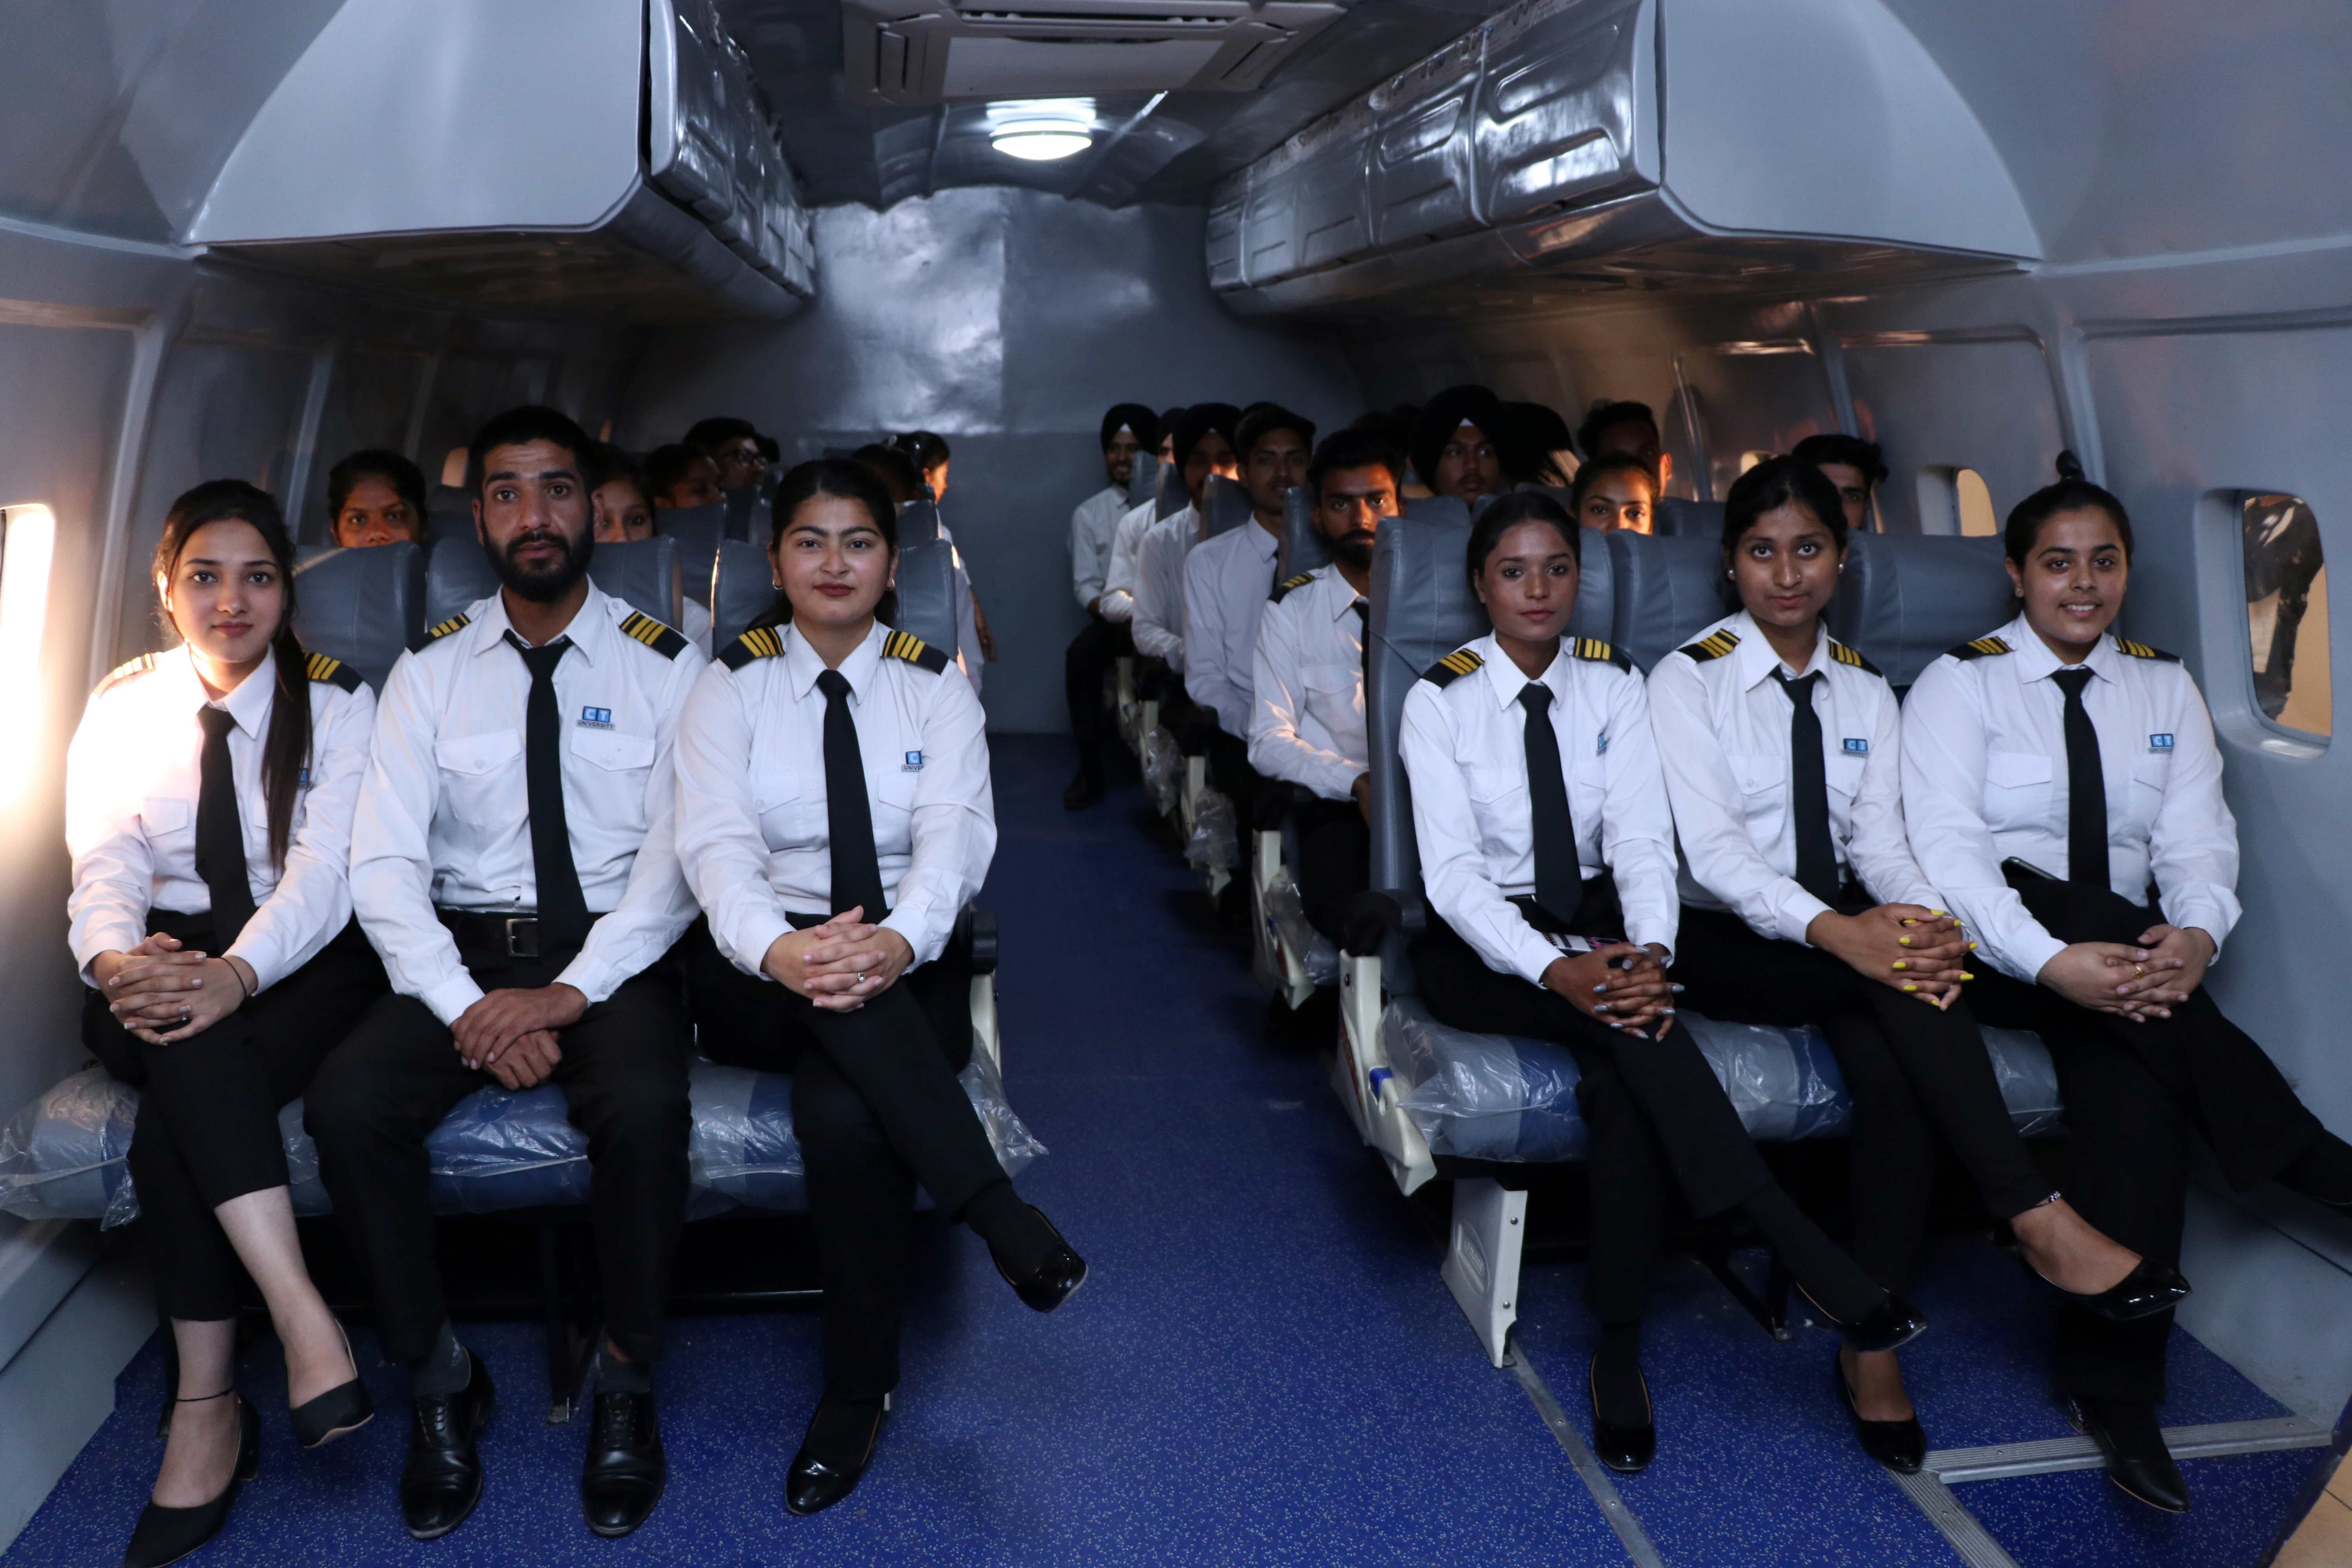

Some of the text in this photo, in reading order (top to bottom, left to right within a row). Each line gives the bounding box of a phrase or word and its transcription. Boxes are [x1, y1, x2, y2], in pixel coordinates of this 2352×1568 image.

[585, 708, 608, 720] CT
[578, 720, 614, 729] UNIVERSITY
[2154, 735, 2172, 746] CT
